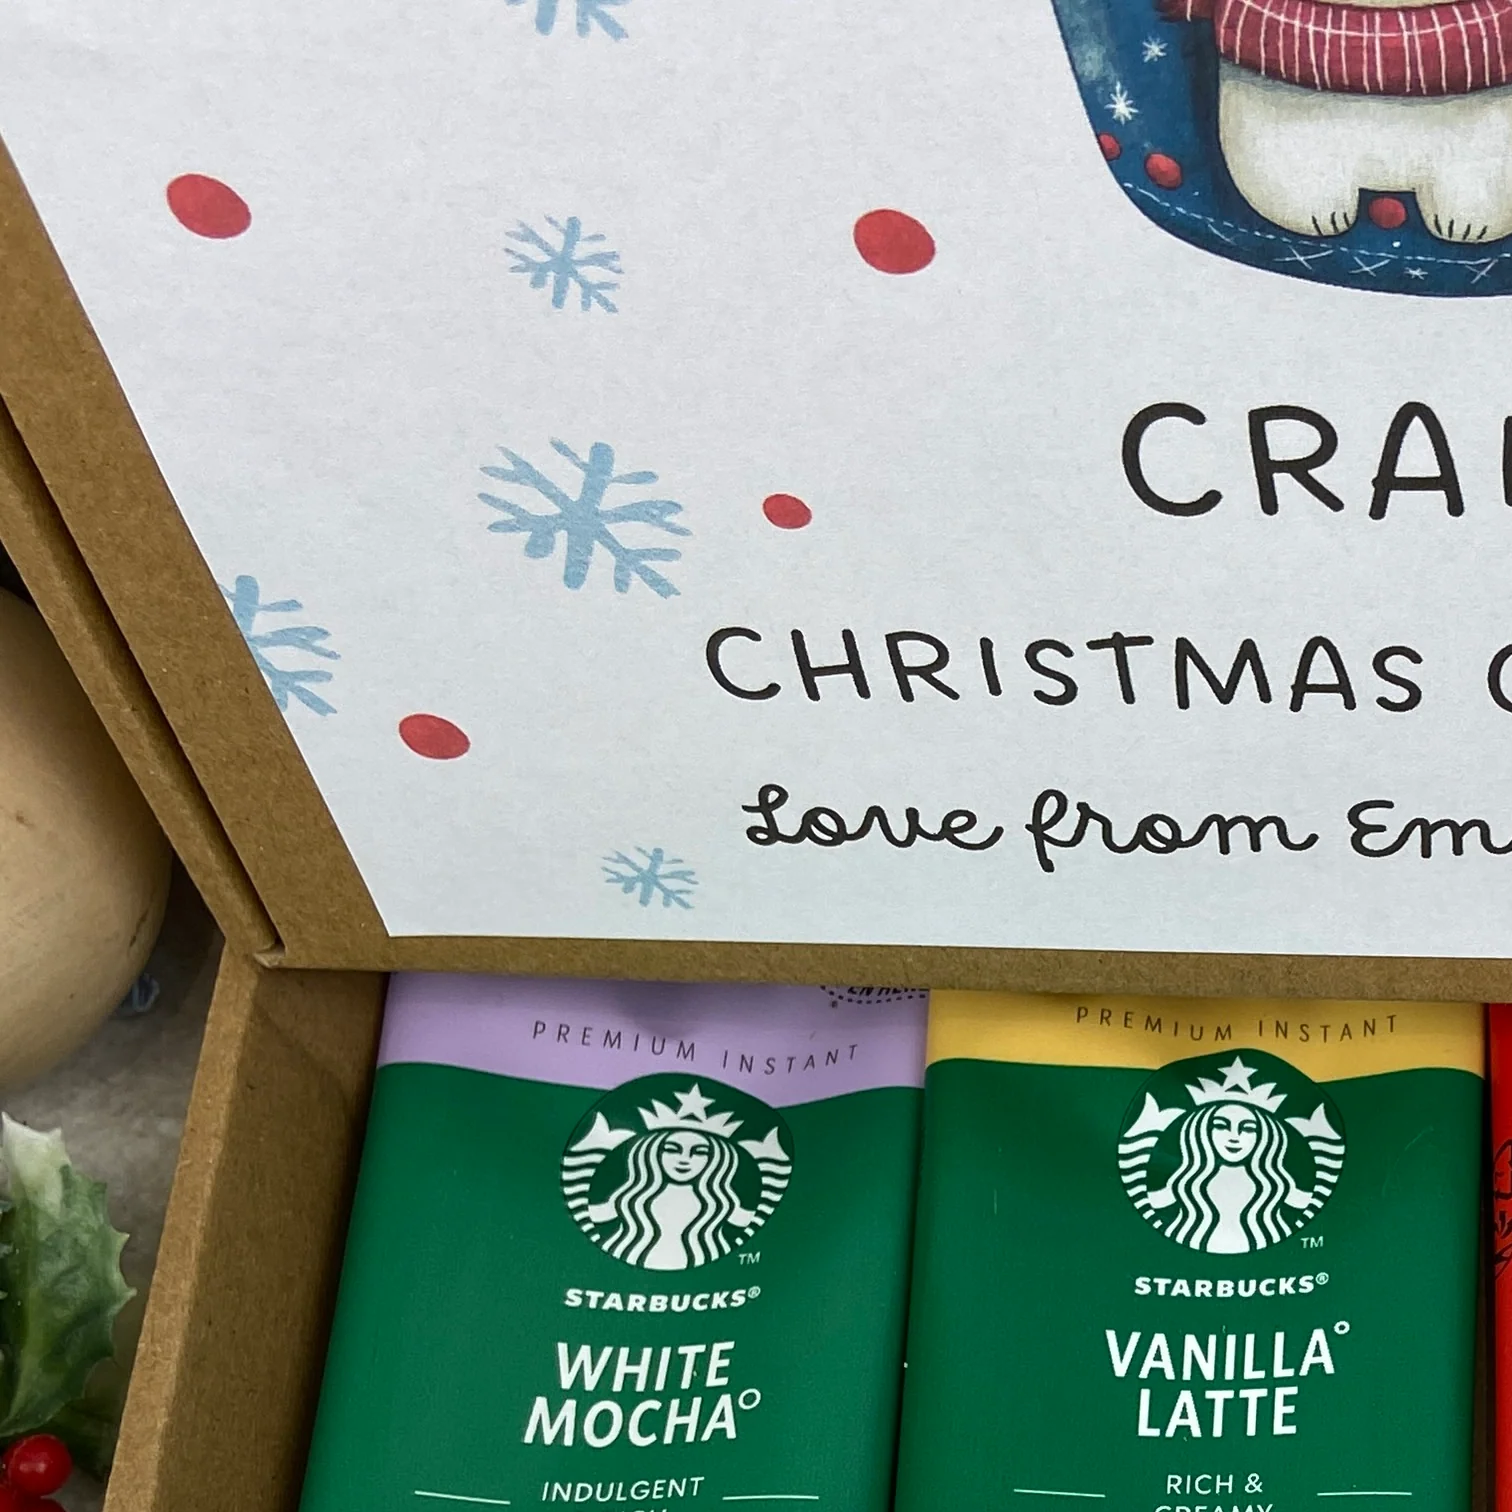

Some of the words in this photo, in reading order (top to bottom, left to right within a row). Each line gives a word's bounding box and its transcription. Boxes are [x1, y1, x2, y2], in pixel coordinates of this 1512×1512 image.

[705, 626, 1423, 713] CHRISTMAS
[743, 783, 1003, 851] Love
[1026, 789, 1318, 873] from
[532, 1020, 697, 1062] PREMIUM
[722, 1043, 860, 1076] INSTANT
[1076, 1006, 1233, 1042] PREMIUM
[1258, 1014, 1399, 1044] INSTANT
[556, 1341, 736, 1393] WHITE
[1136, 1386, 1299, 1439] LATTE
[541, 1476, 705, 1504] INDULGENT
[1166, 1474, 1234, 1496] RICH
[1244, 1473, 1264, 1495] &
